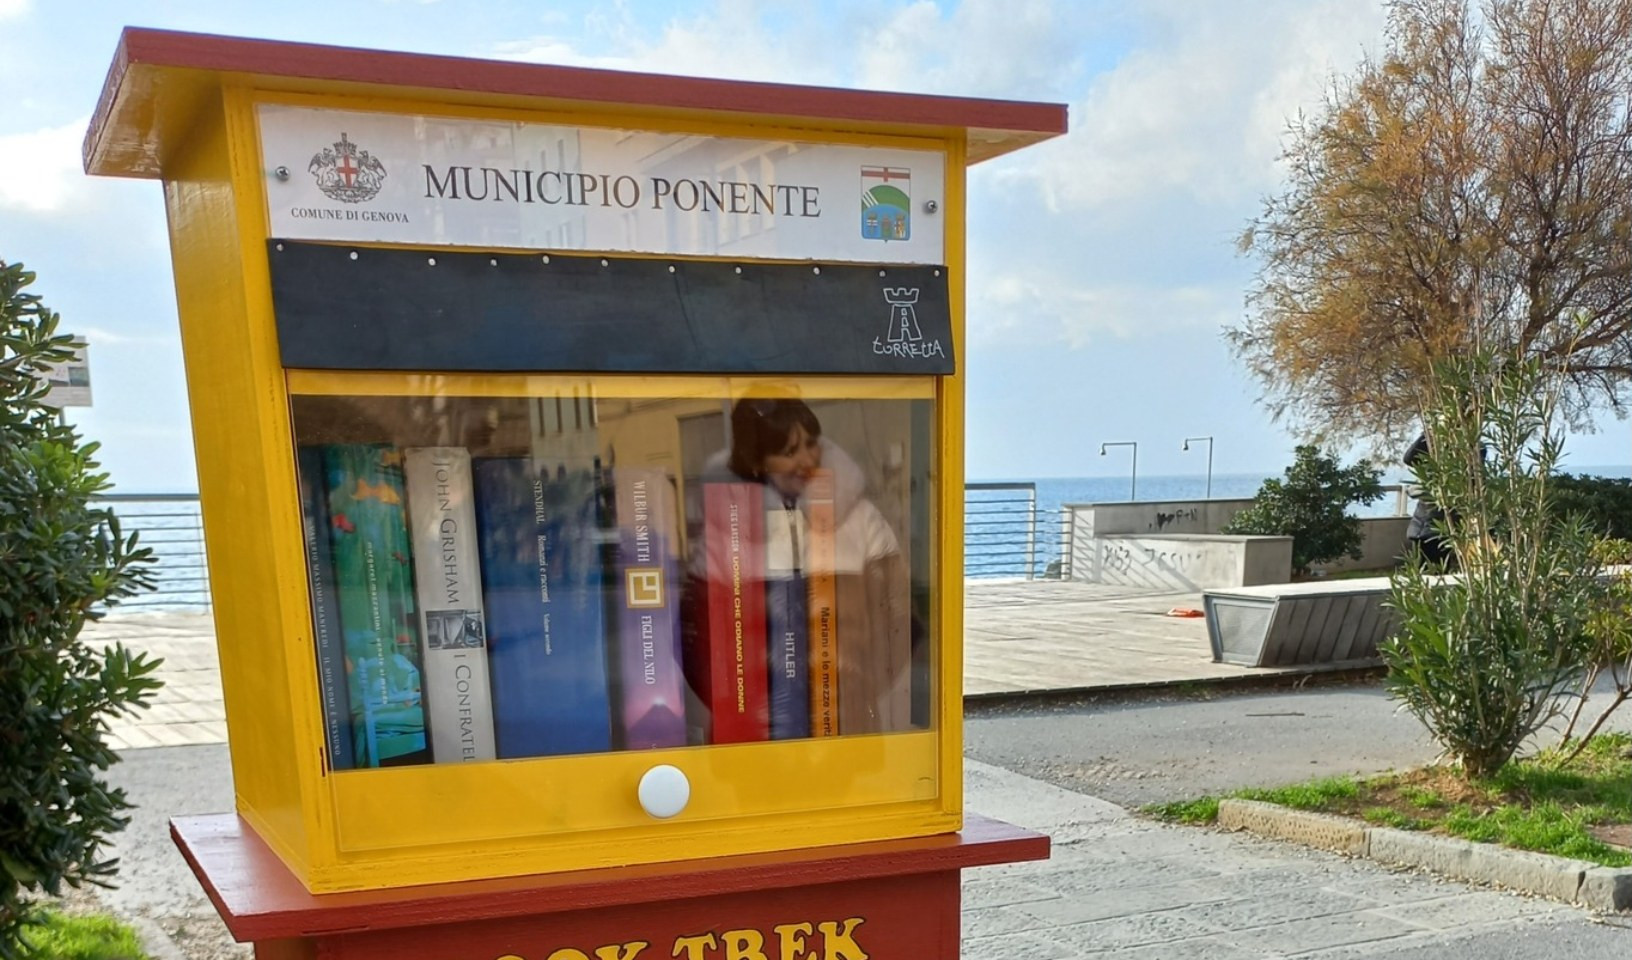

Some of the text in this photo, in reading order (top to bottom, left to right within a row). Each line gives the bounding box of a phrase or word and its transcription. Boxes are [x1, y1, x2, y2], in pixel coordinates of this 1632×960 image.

[422, 163, 822, 219] MUNICIPIO PONENTE
[291, 207, 410, 225] COMUNE DI GENOVA
[431, 462, 450, 511] JOHN
[533, 479, 546, 525] STENDHAL
[633, 481, 651, 563] WILBUR SMITH
[641, 615, 656, 686] FIGLI DEL NILO
[732, 555, 745, 713] UOMINI CHE ODIANO LE DONNE
[820, 606, 830, 649] Mariani
[785, 631, 796, 679] HITLER
